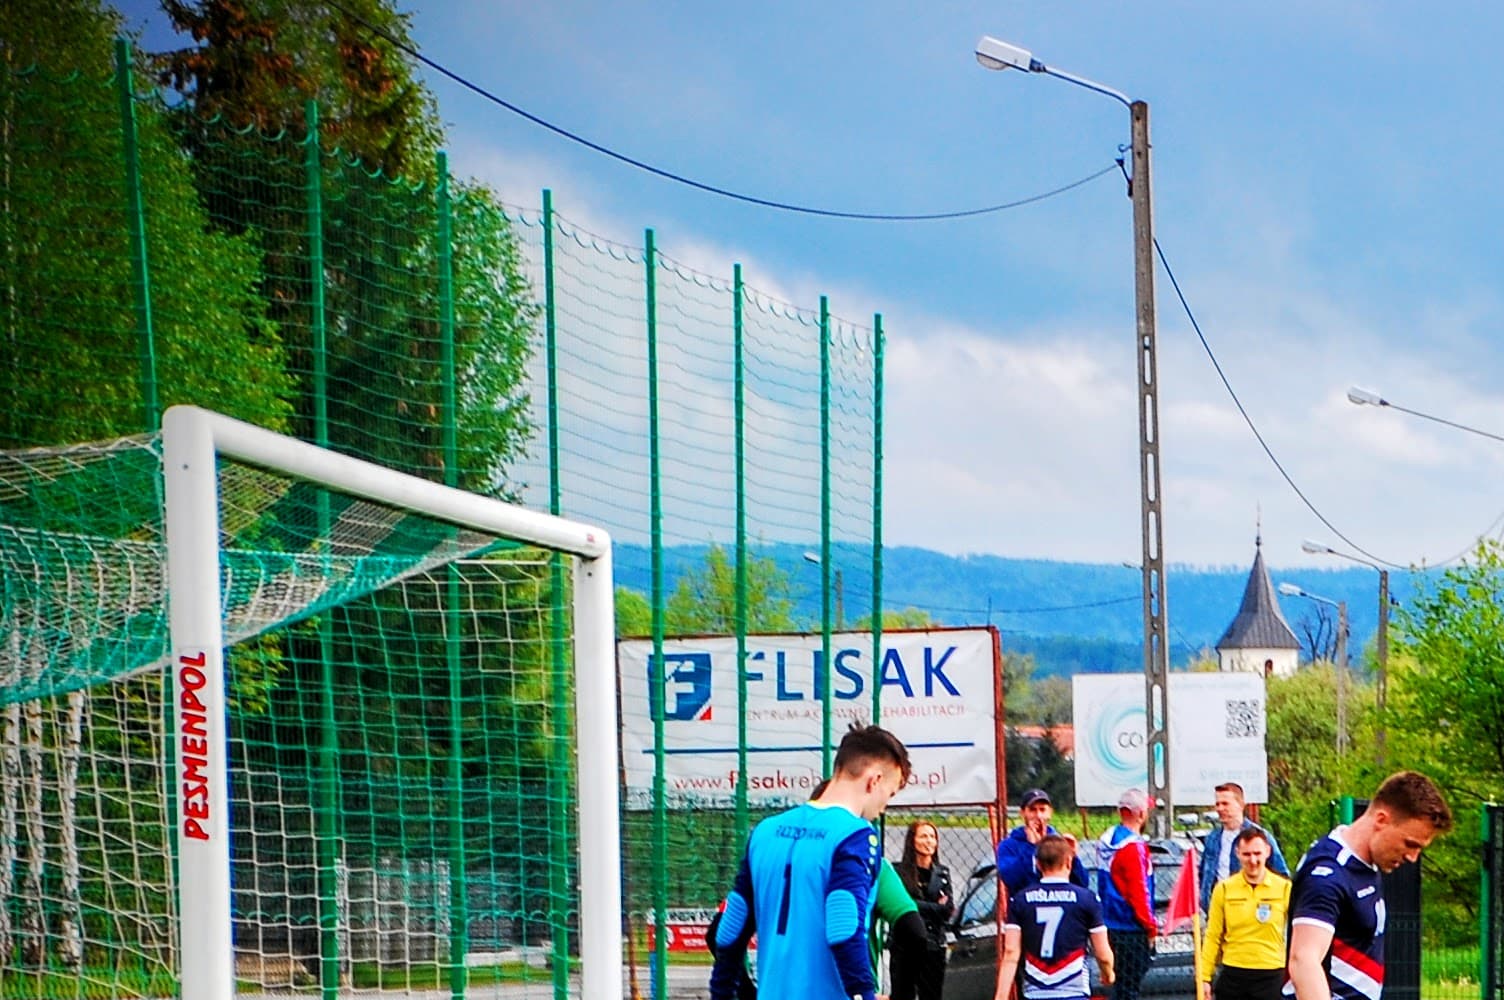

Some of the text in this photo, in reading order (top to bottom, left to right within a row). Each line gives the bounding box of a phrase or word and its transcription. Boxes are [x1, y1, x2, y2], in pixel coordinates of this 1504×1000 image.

[740, 646, 961, 702] FLISAK
[877, 703, 965, 720] EHABILITACJI
[179, 652, 210, 840] PESMENPOL
[777, 863, 792, 936] 1
[1036, 906, 1064, 958] 7
